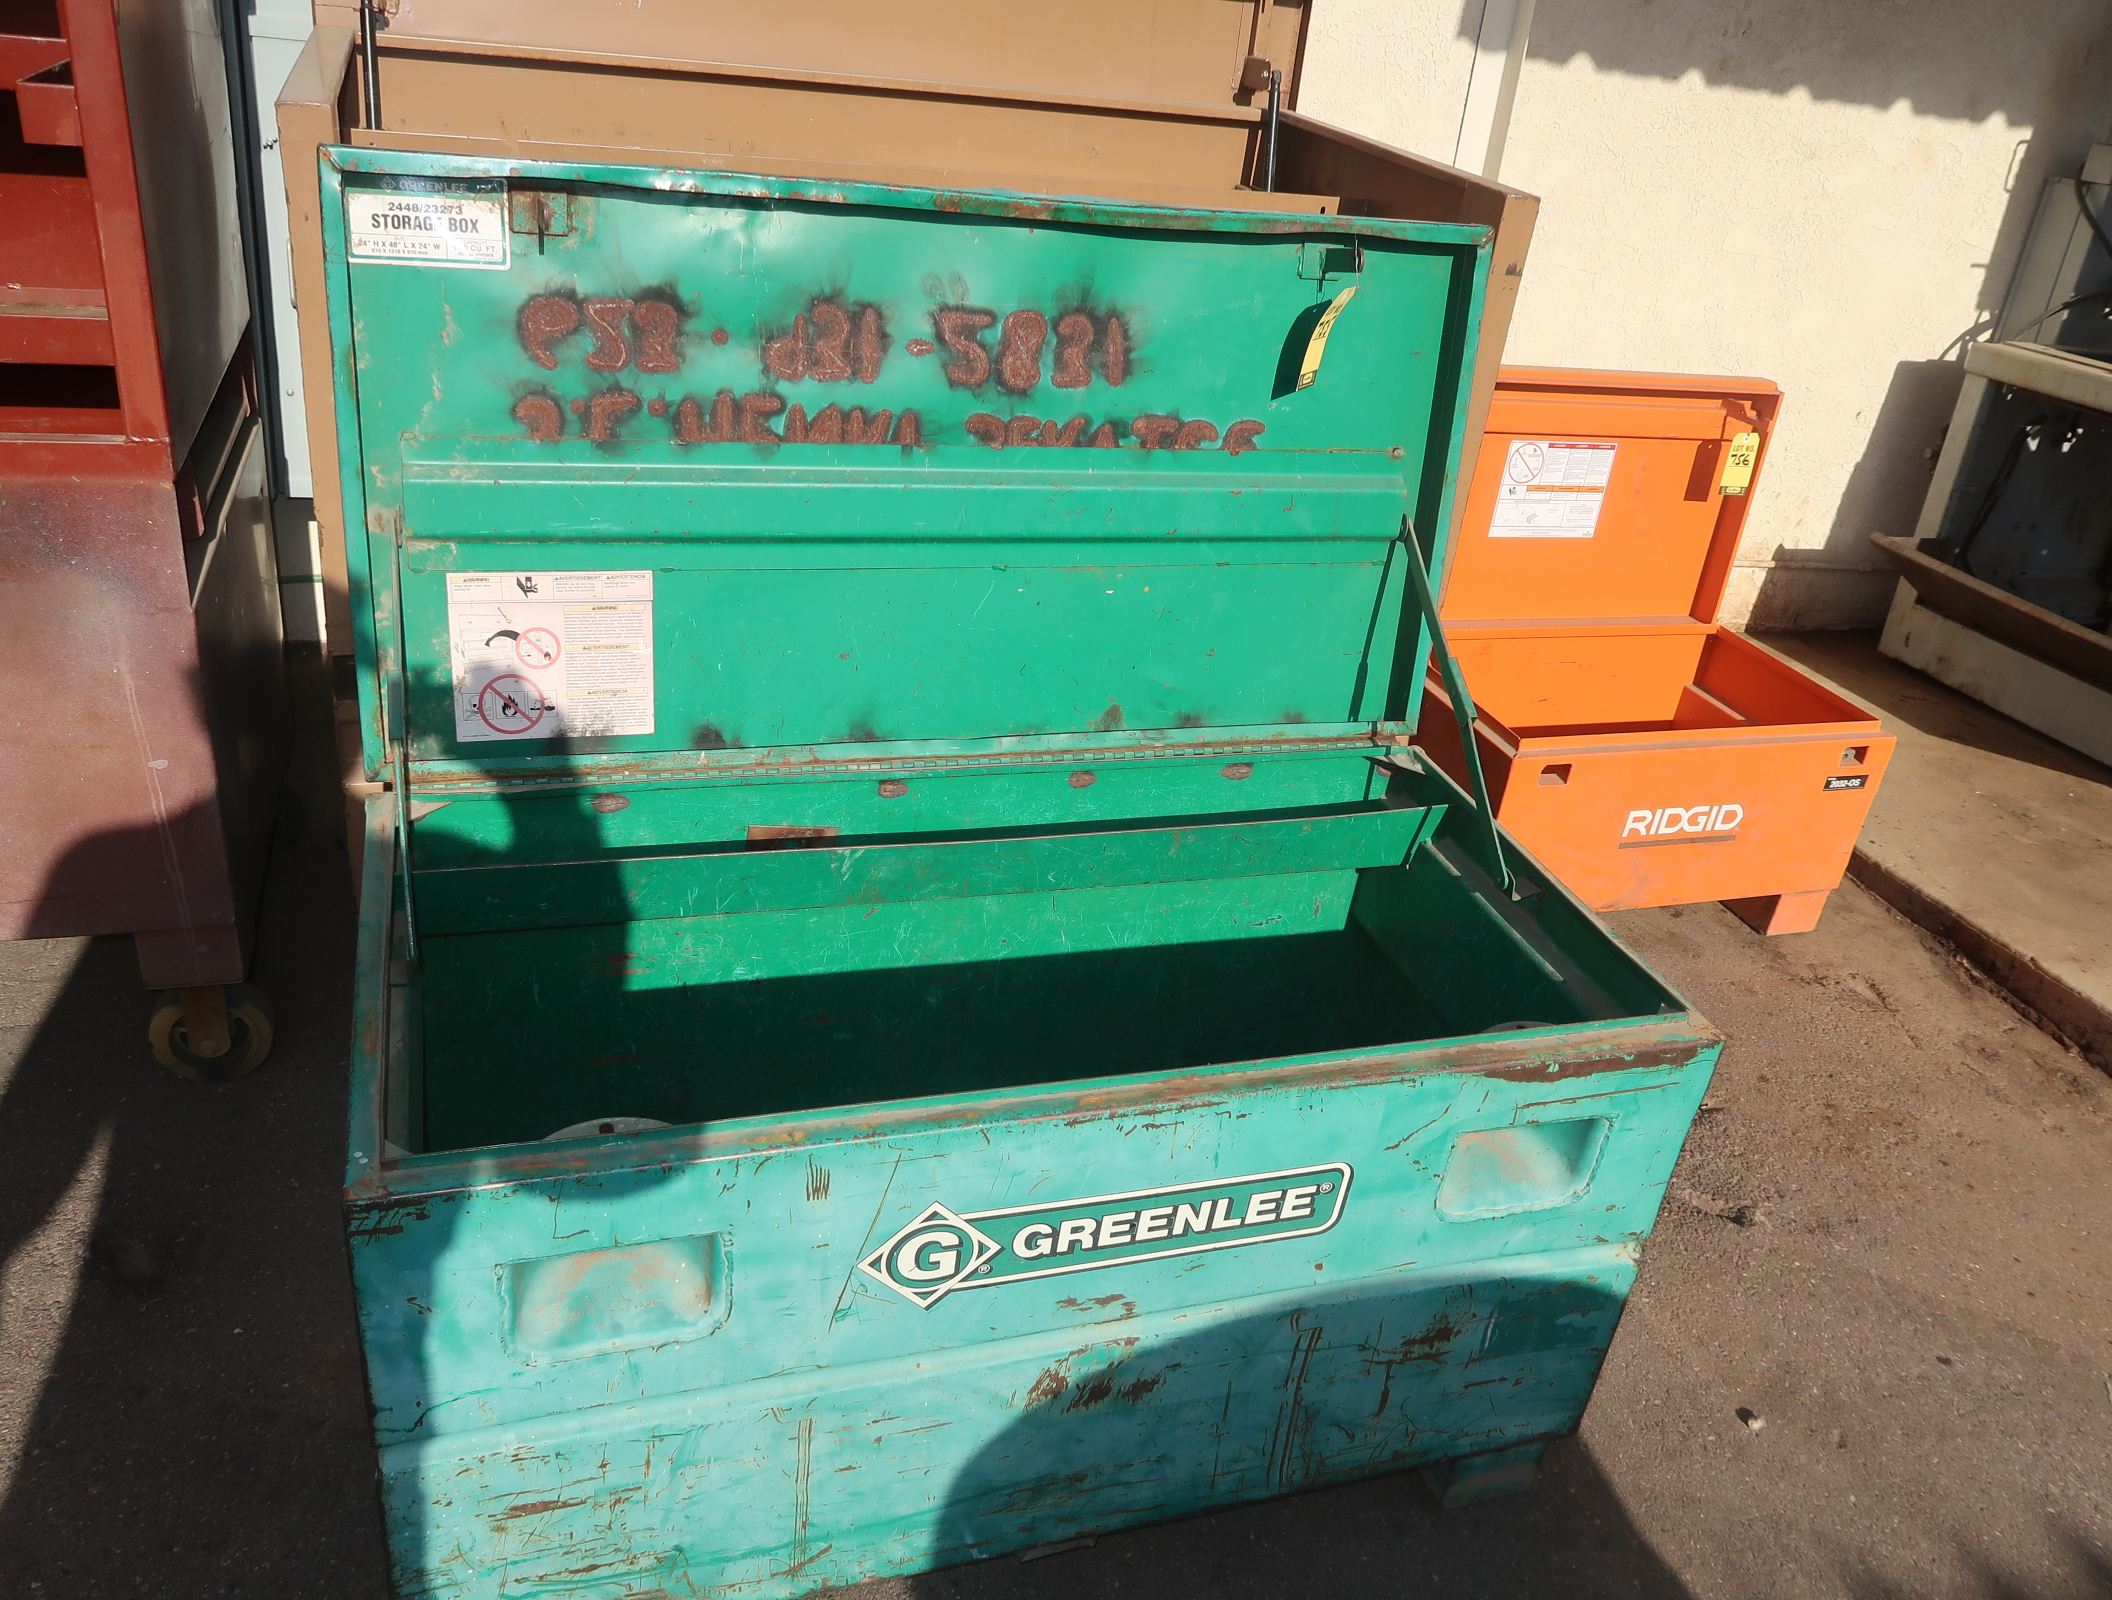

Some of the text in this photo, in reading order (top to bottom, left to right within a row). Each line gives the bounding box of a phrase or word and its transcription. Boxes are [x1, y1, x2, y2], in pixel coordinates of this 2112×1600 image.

[387, 202, 463, 215] 2448/23273
[448, 217, 480, 234] BOX
[418, 242, 431, 250] 24"
[1733, 444, 1745, 452] LOT
[1731, 453, 1750, 466] 756
[1621, 803, 1744, 837] RIDGID
[1011, 1184, 1320, 1260] GREENLEE
